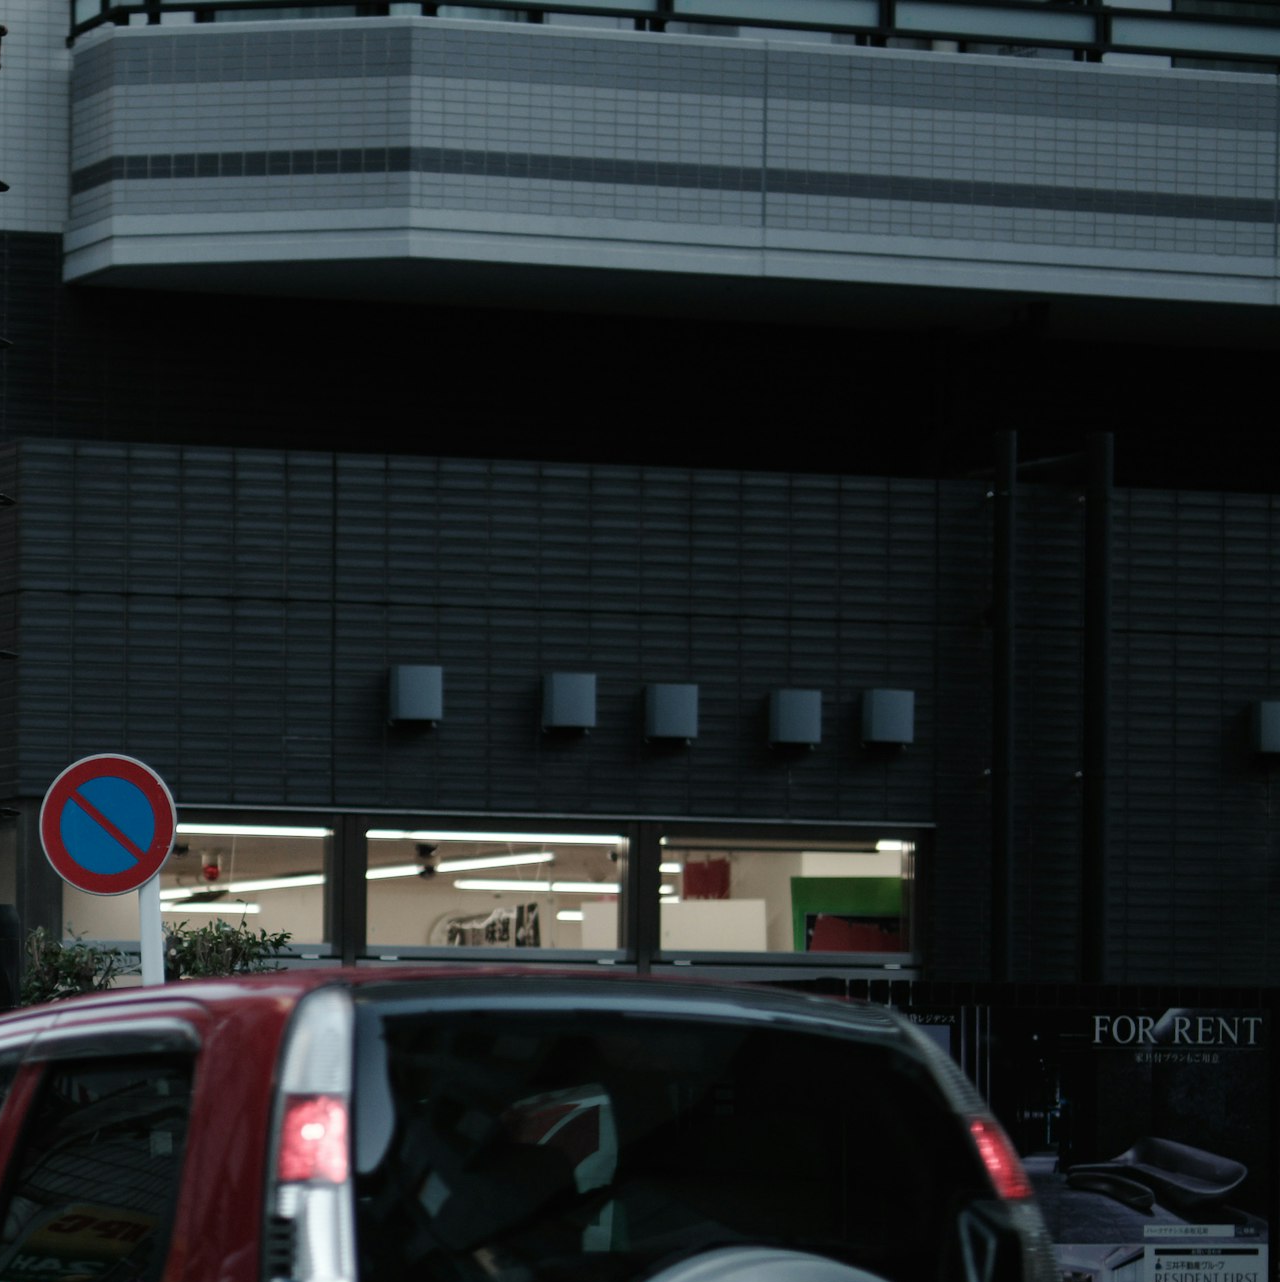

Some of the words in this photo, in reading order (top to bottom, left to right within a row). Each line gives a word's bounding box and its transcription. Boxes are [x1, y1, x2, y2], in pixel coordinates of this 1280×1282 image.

[1091, 1015, 1158, 1044] FOR
[1172, 1016, 1263, 1046] RENT
[1165, 1261, 1225, 1270] 三井不動産グループ
